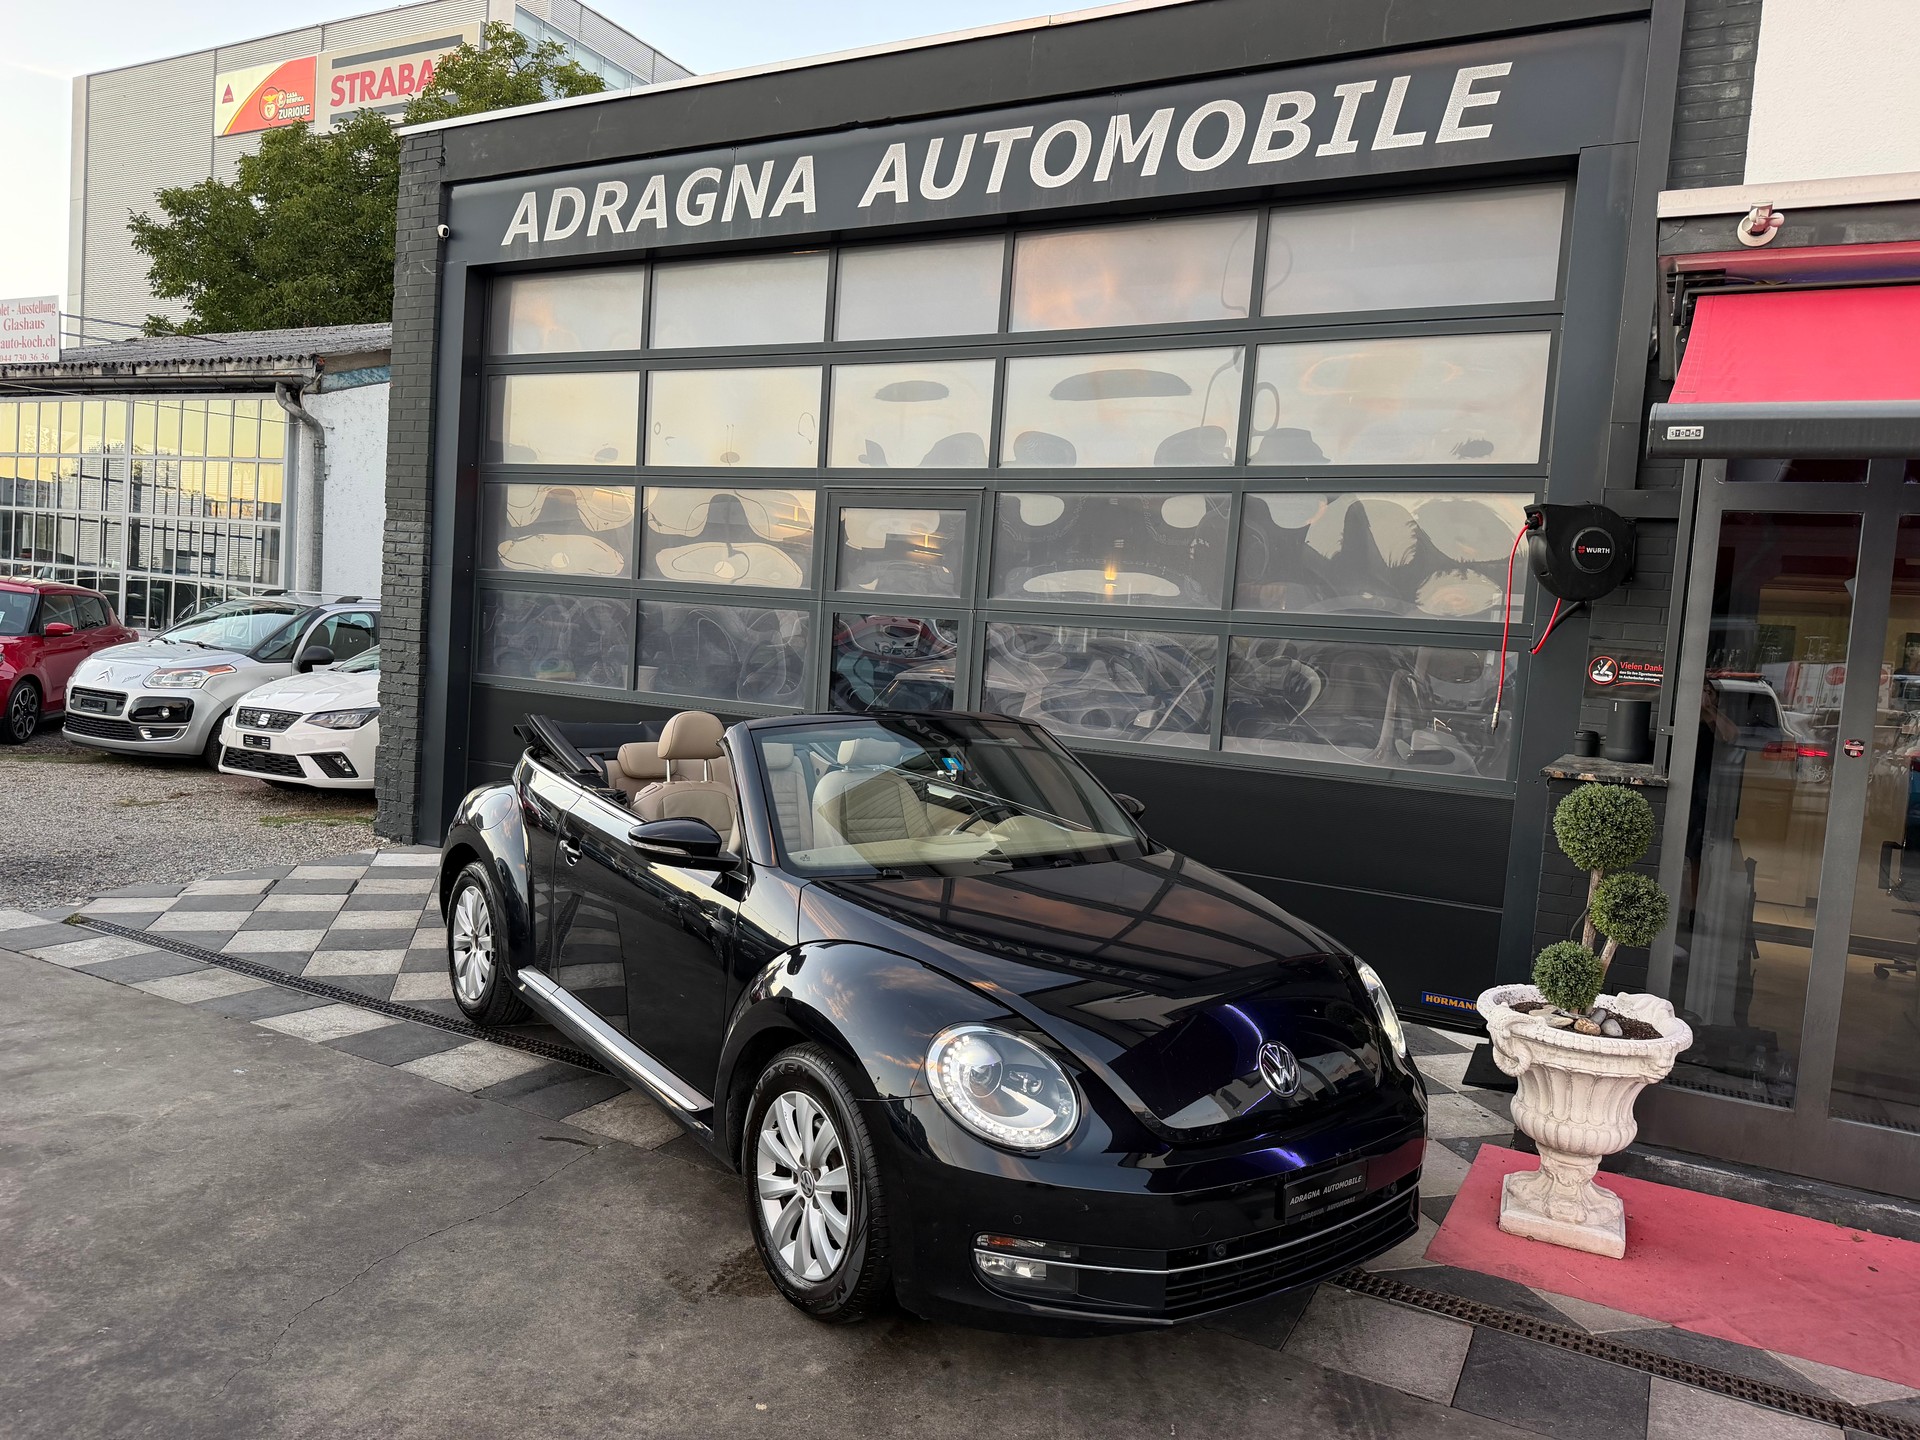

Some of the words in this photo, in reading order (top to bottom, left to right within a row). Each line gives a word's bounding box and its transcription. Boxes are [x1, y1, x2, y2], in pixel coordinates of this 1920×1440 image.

[330, 58, 448, 107] STRABA
[278, 104, 311, 120] ZURIQUE
[501, 156, 817, 246] ADRAGNA
[857, 61, 1514, 209] AUTOMOBILE
[17, 300, 56, 317] Ausstellung
[3, 317, 46, 331] Glashaus
[29, 353, 38, 361] 36
[40, 352, 50, 361] 36
[1620, 661, 1642, 670] Vielen
[1644, 663, 1663, 672] Dank
[1289, 1189, 1320, 1205] ADRAGNA
[1322, 1175, 1363, 1195] AUTOMOBILE
